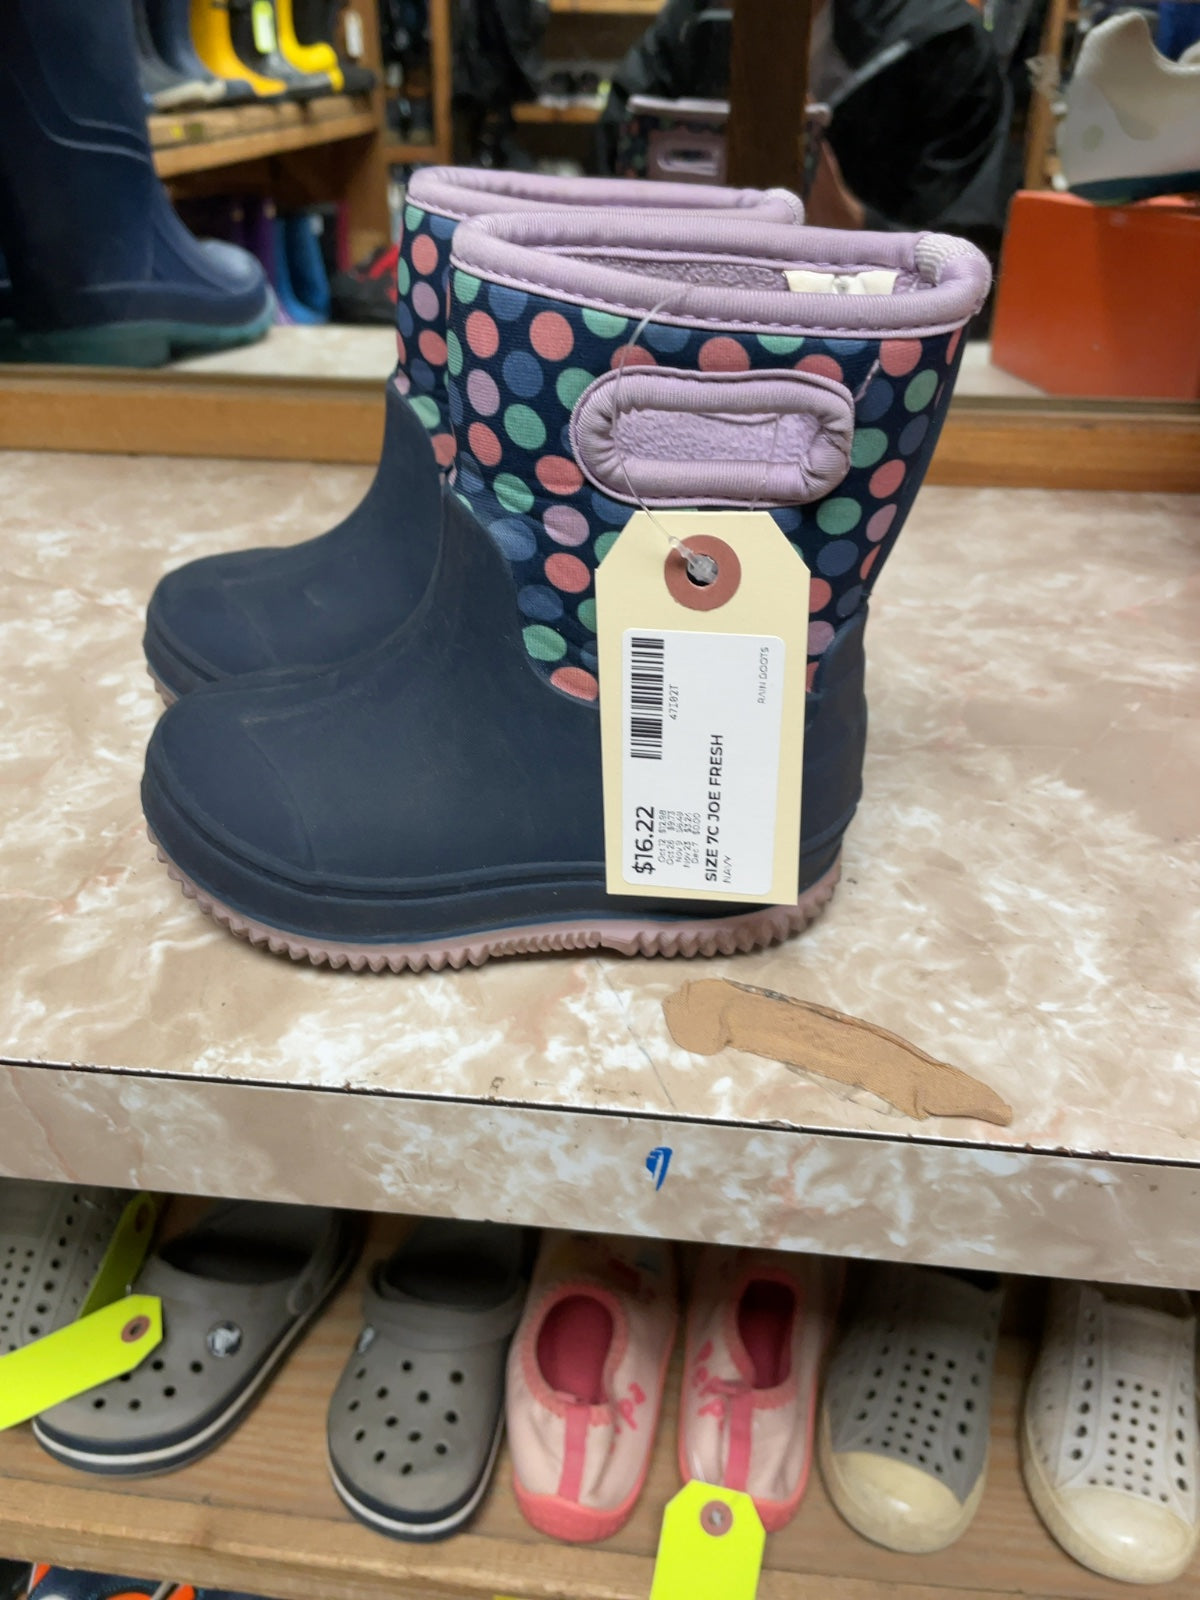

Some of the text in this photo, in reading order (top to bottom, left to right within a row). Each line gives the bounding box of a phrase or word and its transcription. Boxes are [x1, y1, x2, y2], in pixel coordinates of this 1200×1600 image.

[757, 647, 770, 704] RAIN BOOTS
[705, 734, 723, 882] SIZE 7C JOE FRESH
[658, 809, 667, 834] $12.98
[691, 812, 701, 835] $0.00
[631, 806, 656, 875] $16.22
[666, 839, 675, 850] 26
[657, 848, 666, 863] Oct
[666, 850, 674, 866] Oct
[675, 847, 684, 863] Nov
[691, 847, 699, 864] Dec
[722, 855, 732, 884] NAVY
